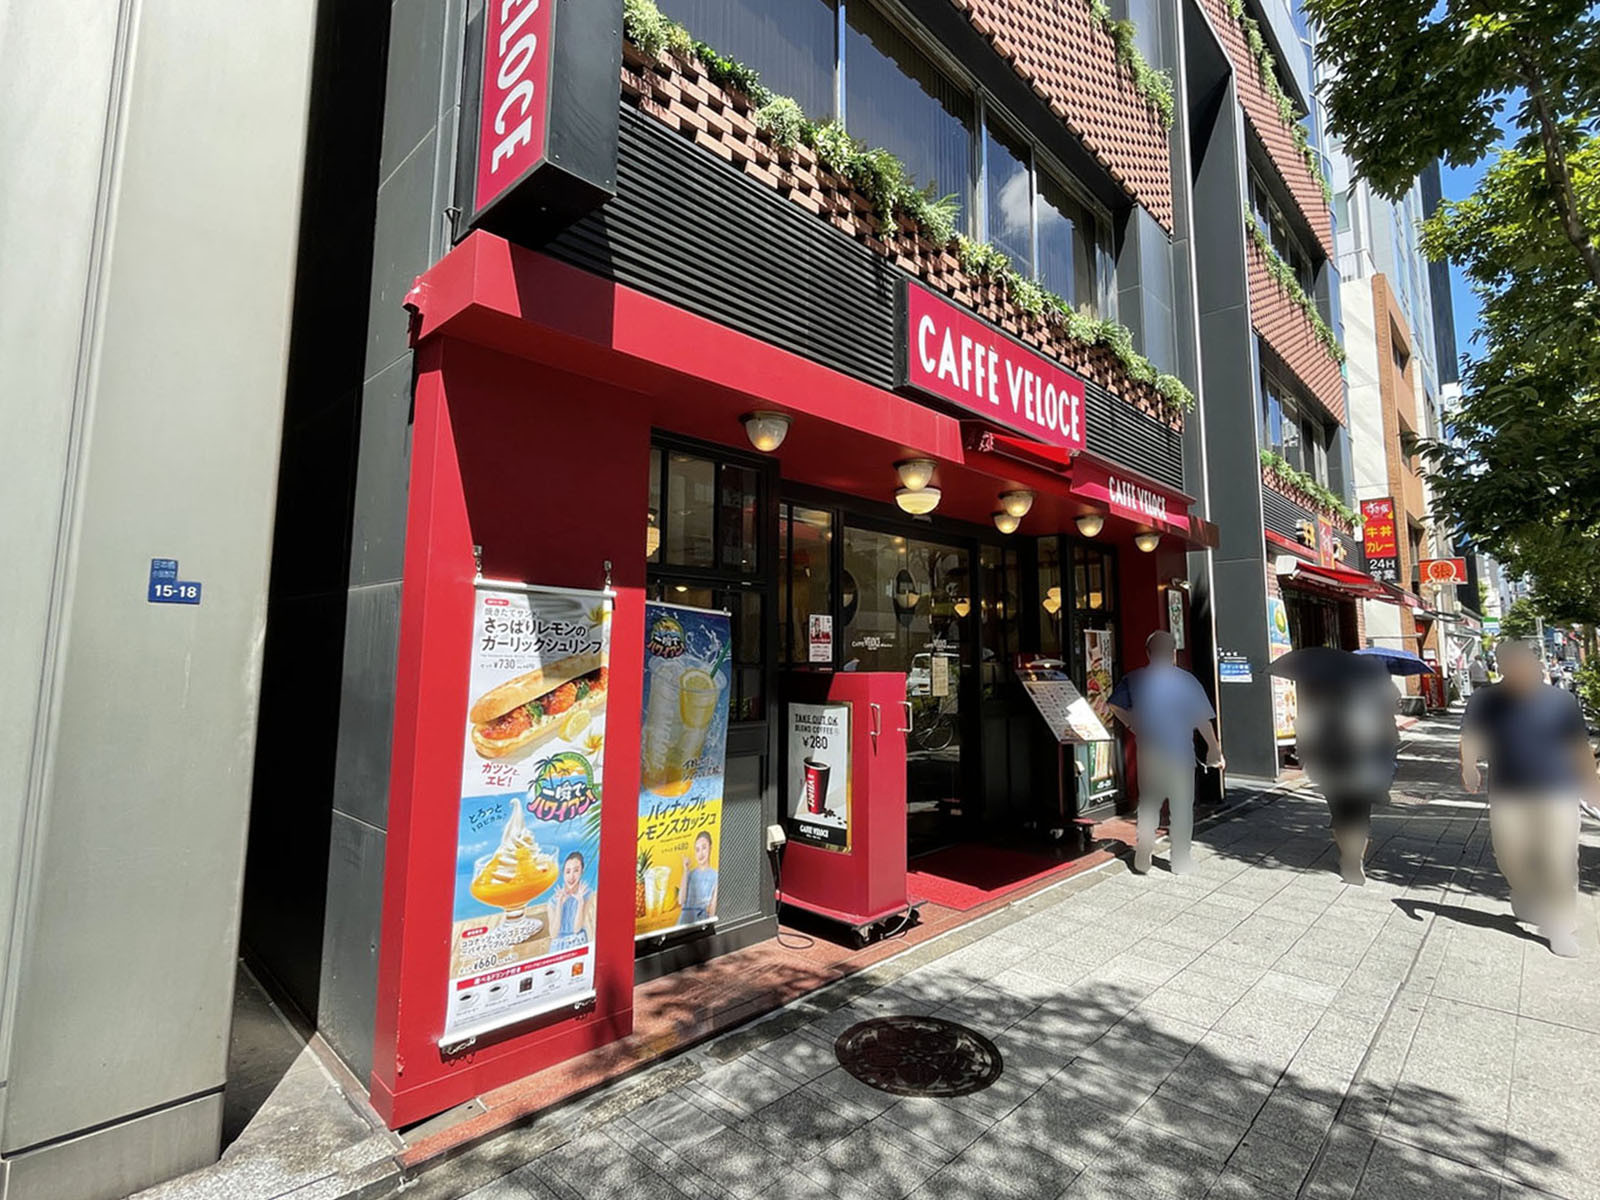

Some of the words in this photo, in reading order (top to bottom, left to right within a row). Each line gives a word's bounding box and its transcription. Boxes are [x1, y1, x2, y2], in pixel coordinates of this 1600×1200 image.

[918, 314, 1000, 405] CAFFÈ
[1005, 359, 1080, 442] VELOCE
[1366, 541, 1394, 553] カレー
[1369, 558, 1395, 570] 24H
[154, 584, 197, 598] 15-18
[484, 617, 587, 637] さっぱりレモンの
[494, 658, 516, 670] ¥730
[795, 713, 811, 723] TAKE
[802, 735, 828, 750] ¥280
[482, 763, 520, 777] ガツンと
[468, 803, 503, 824] とろっと
[647, 795, 706, 822] パイナップル
[473, 954, 498, 970] ¥660
